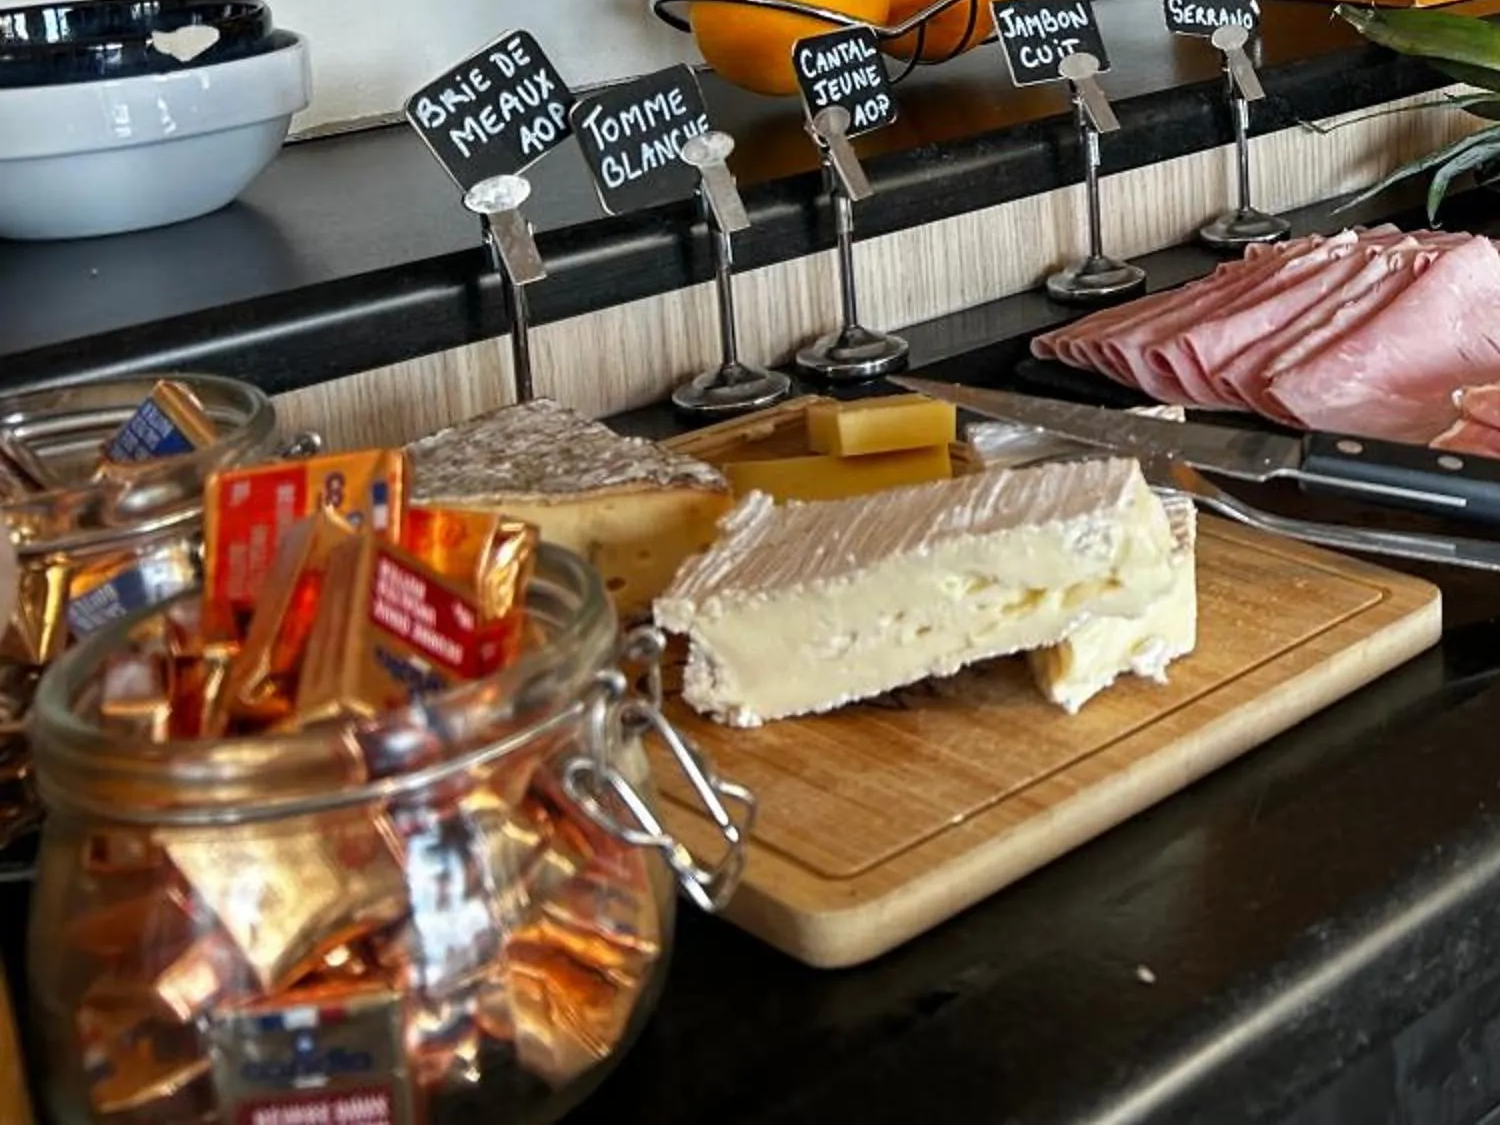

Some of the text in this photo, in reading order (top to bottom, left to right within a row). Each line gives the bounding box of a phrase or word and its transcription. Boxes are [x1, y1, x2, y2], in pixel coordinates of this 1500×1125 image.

[999, 2, 1089, 39] JAMBON
[489, 37, 531, 78] DE
[800, 38, 877, 78] CANTAL
[813, 64, 881, 106] JEUNE
[450, 68, 555, 158] MEAUX
[519, 102, 567, 154] AOP
[582, 88, 687, 151] TOMME
[854, 93, 890, 127] AOP
